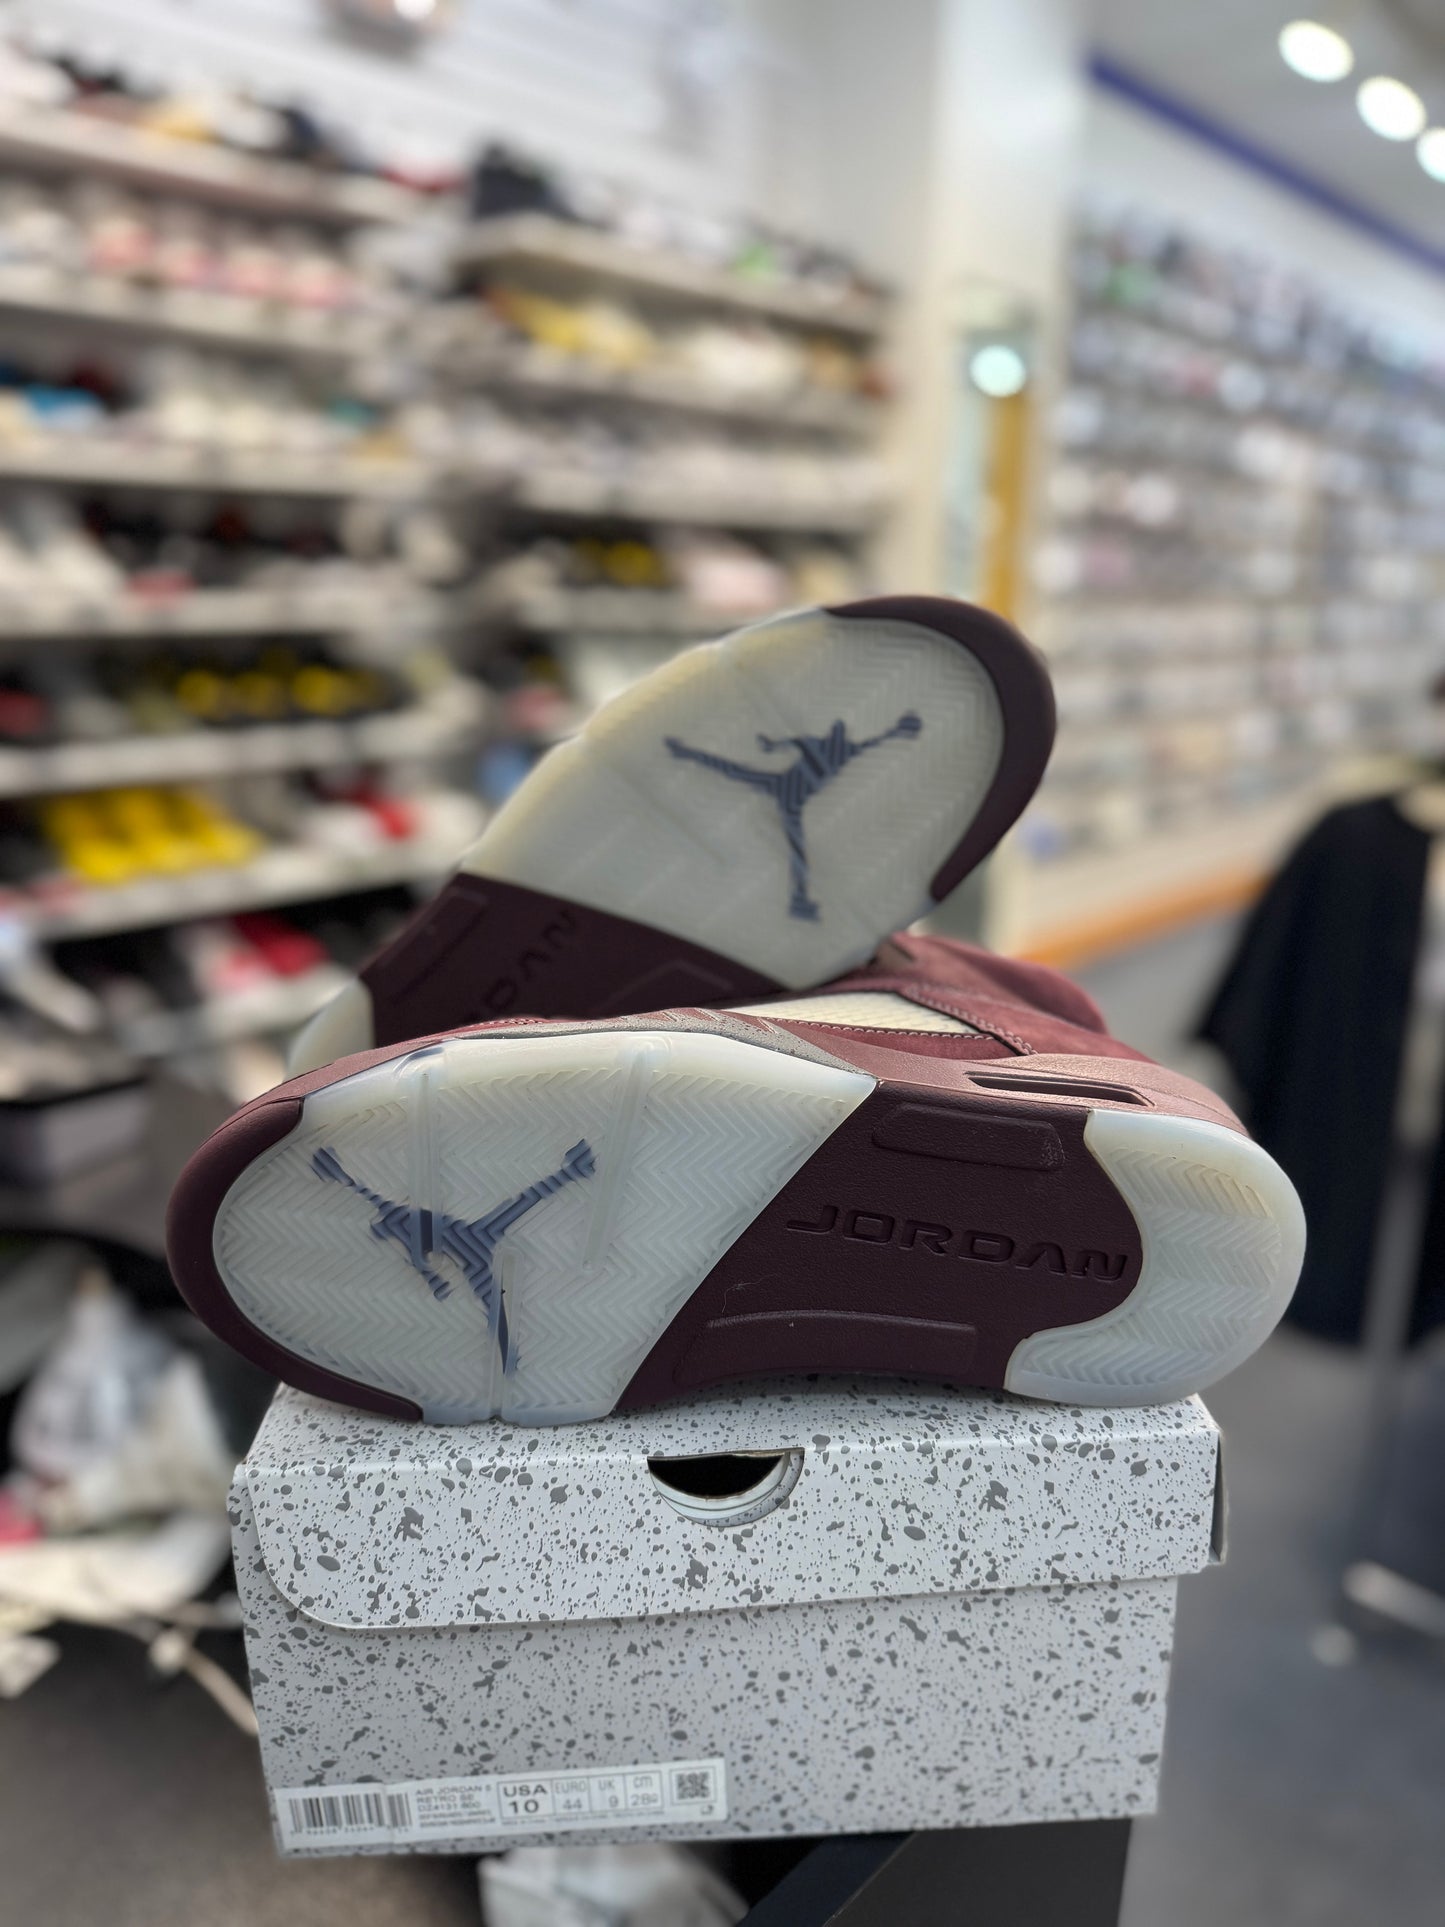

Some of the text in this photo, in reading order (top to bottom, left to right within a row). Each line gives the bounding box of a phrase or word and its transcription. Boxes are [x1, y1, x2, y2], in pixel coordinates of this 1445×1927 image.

[786, 1204, 1128, 1282] JORDAN
[415, 1787, 434, 1796] AIR
[437, 1785, 483, 1795] JORDAN
[503, 1784, 548, 1798] USA
[555, 1780, 588, 1794] EURO
[598, 1779, 615, 1791] UK
[416, 1795, 457, 1804] RETRO
[508, 1799, 540, 1814] 10
[562, 1797, 583, 1810] 44
